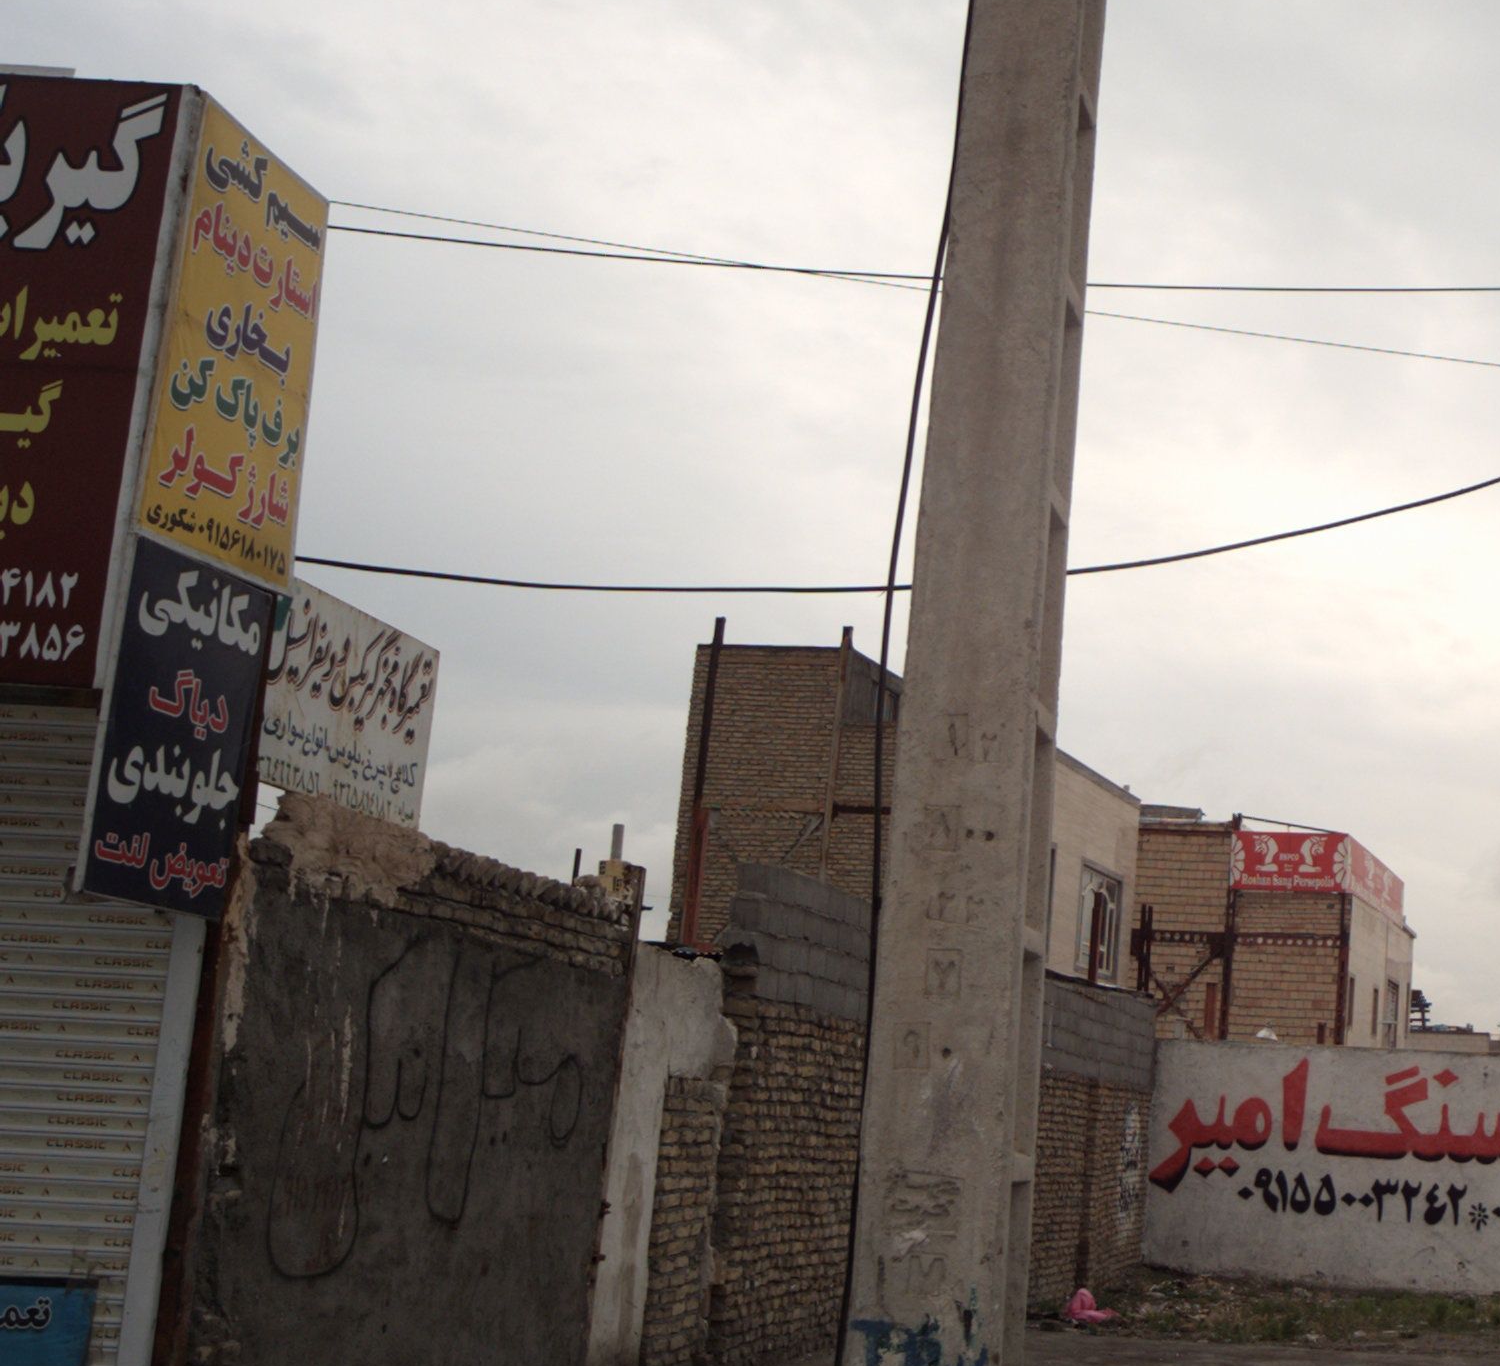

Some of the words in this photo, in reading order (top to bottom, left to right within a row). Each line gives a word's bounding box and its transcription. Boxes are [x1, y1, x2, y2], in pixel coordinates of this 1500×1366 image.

[204, 139, 269, 203] کشی
[192, 202, 254, 277] دینام
[265, 190, 321, 255] سیم
[253, 245, 320, 323] استارت
[205, 302, 293, 387] بخاری
[169, 357, 217, 411] کن
[214, 376, 259, 449] پاک
[157, 425, 246, 500] کولر
[261, 393, 301, 471] برف
[146, 504, 198, 534] شکوری
[237, 463, 291, 531] شارژ
[138, 570, 261, 656] مکانیکی
[149, 669, 229, 741] دیاگ
[94, 832, 151, 870] لنت
[149, 842, 231, 899] تعویض
[1148, 1056, 1311, 1195] امیر
[1237, 1167, 1468, 1227] ۰۹۱۵۵۰۰۳۲۴۲
